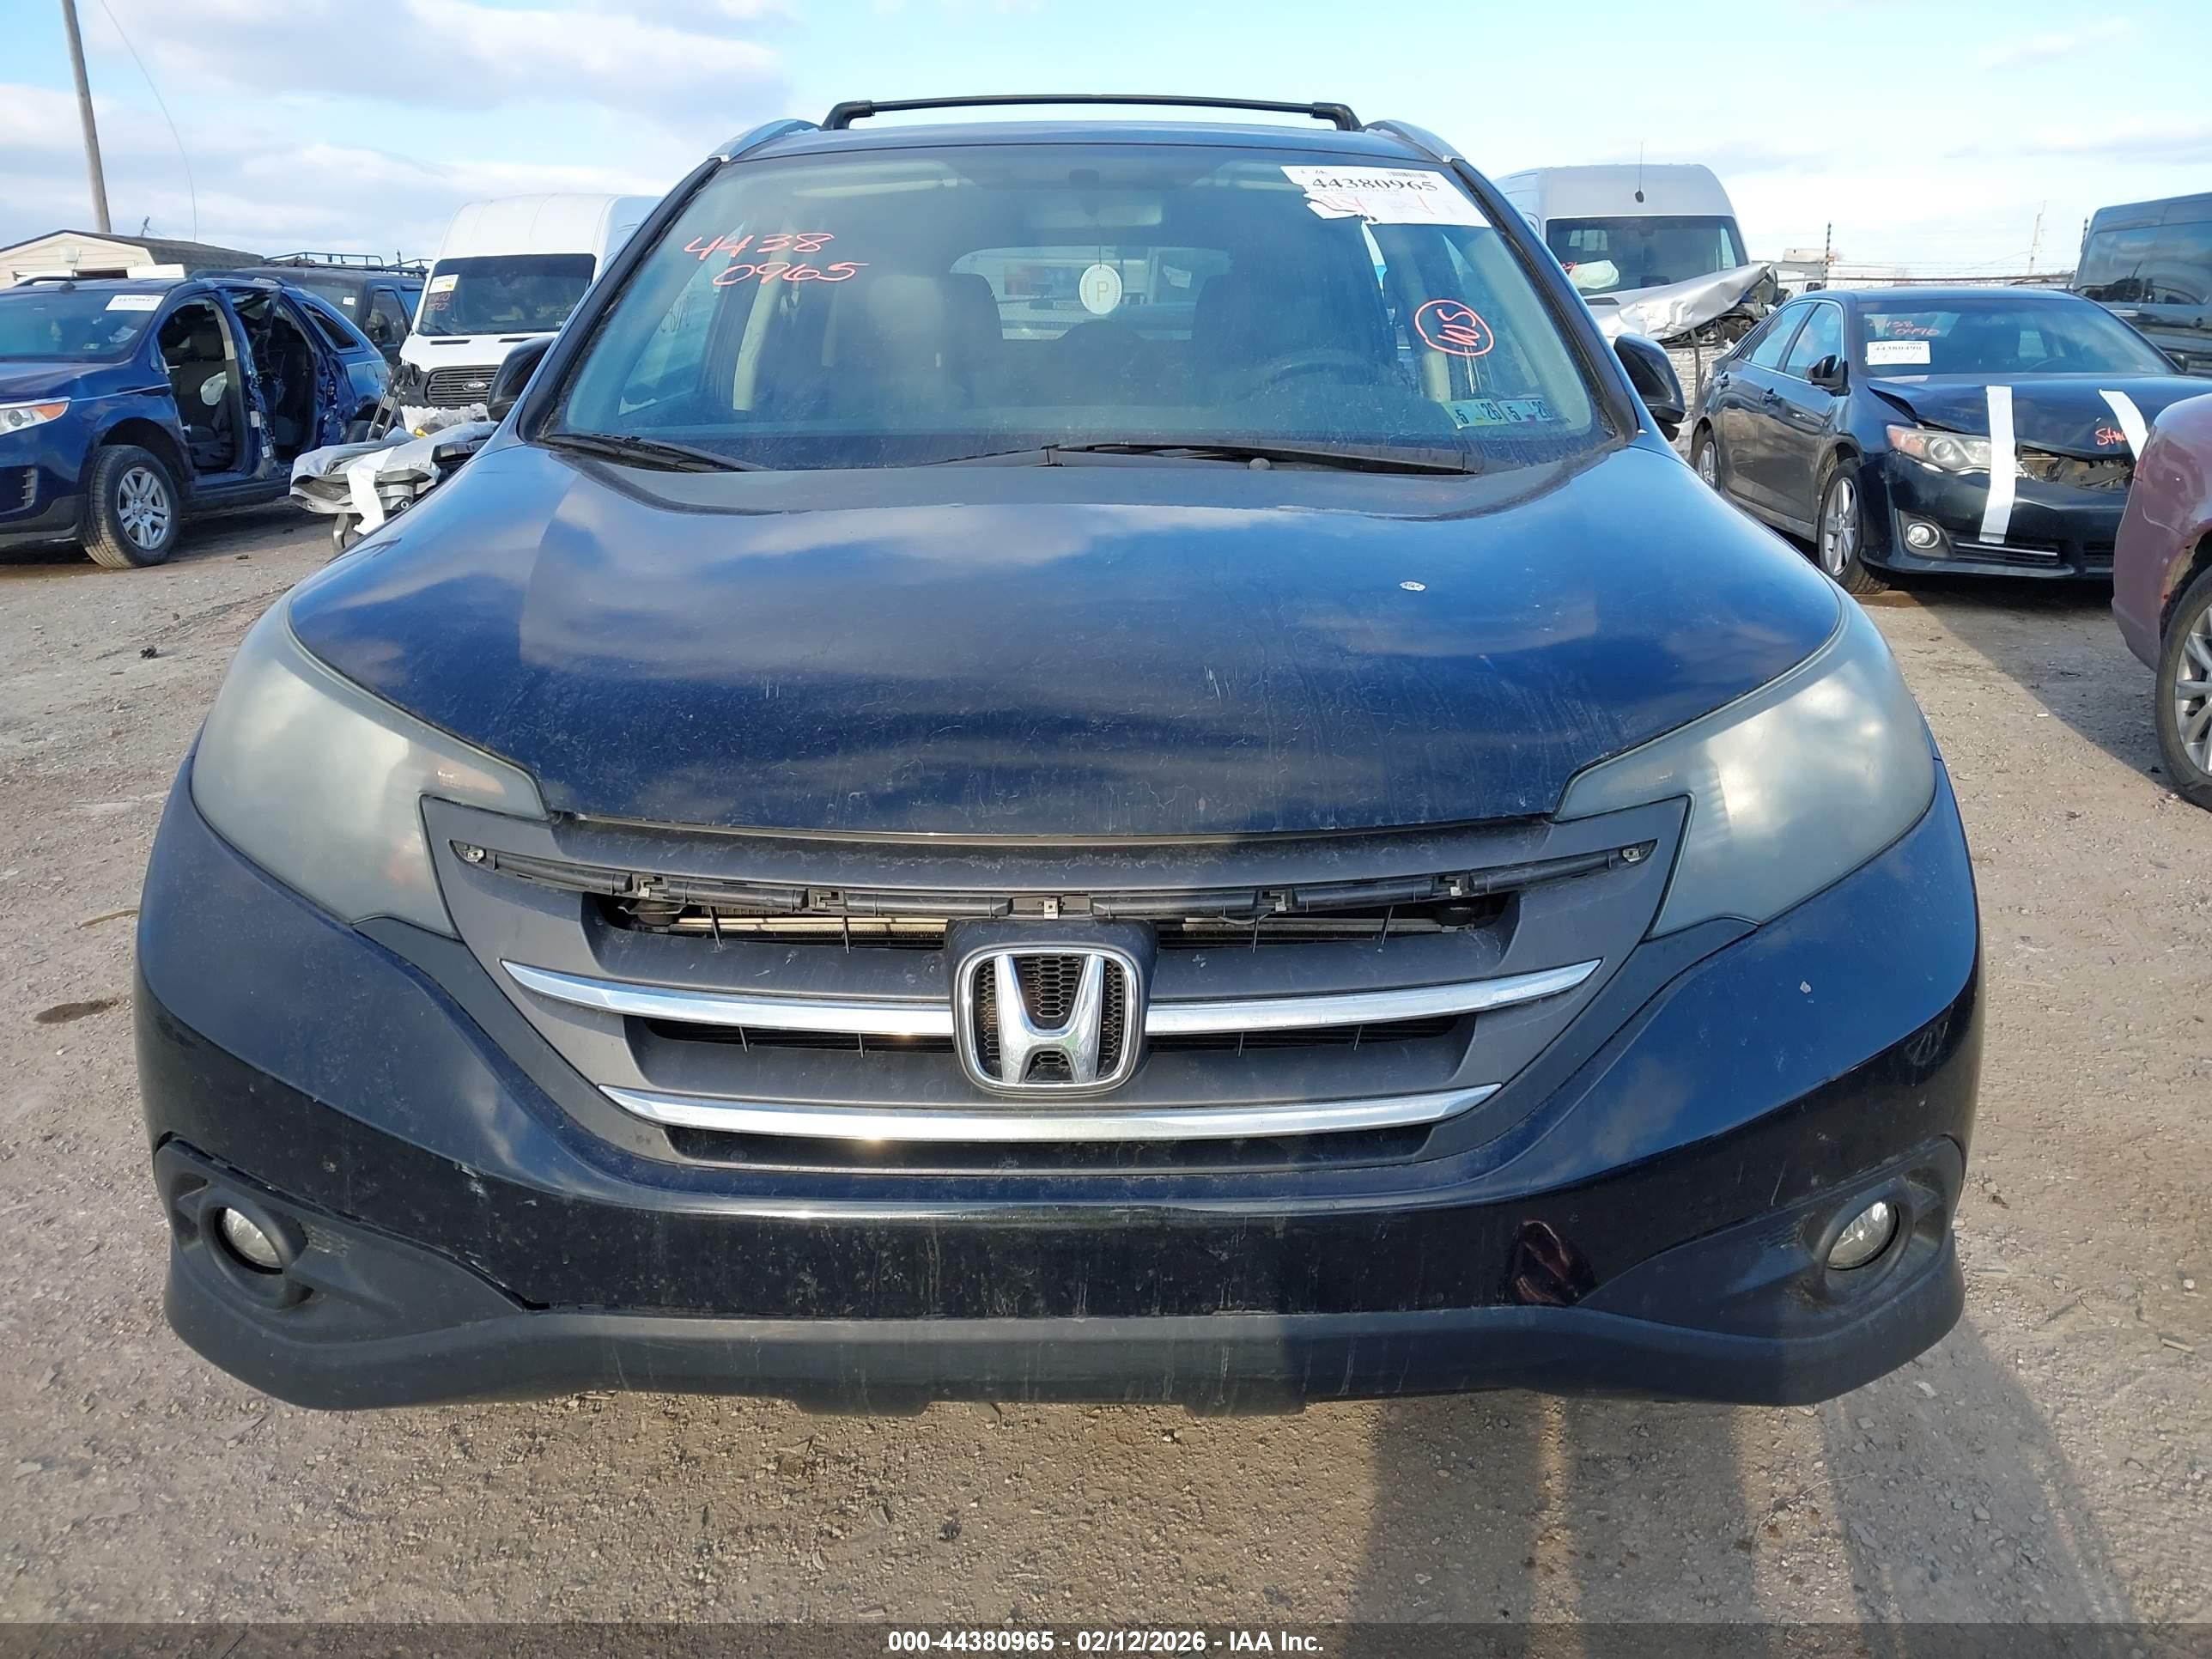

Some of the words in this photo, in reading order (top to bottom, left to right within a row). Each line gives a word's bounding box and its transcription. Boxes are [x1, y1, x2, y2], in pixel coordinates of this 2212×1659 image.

[1312, 177, 1438, 192] 44380965
[684, 233, 836, 261] 4438
[712, 261, 870, 286] 0965
[1455, 409, 1470, 425] 5
[1507, 405, 1522, 422] 5
